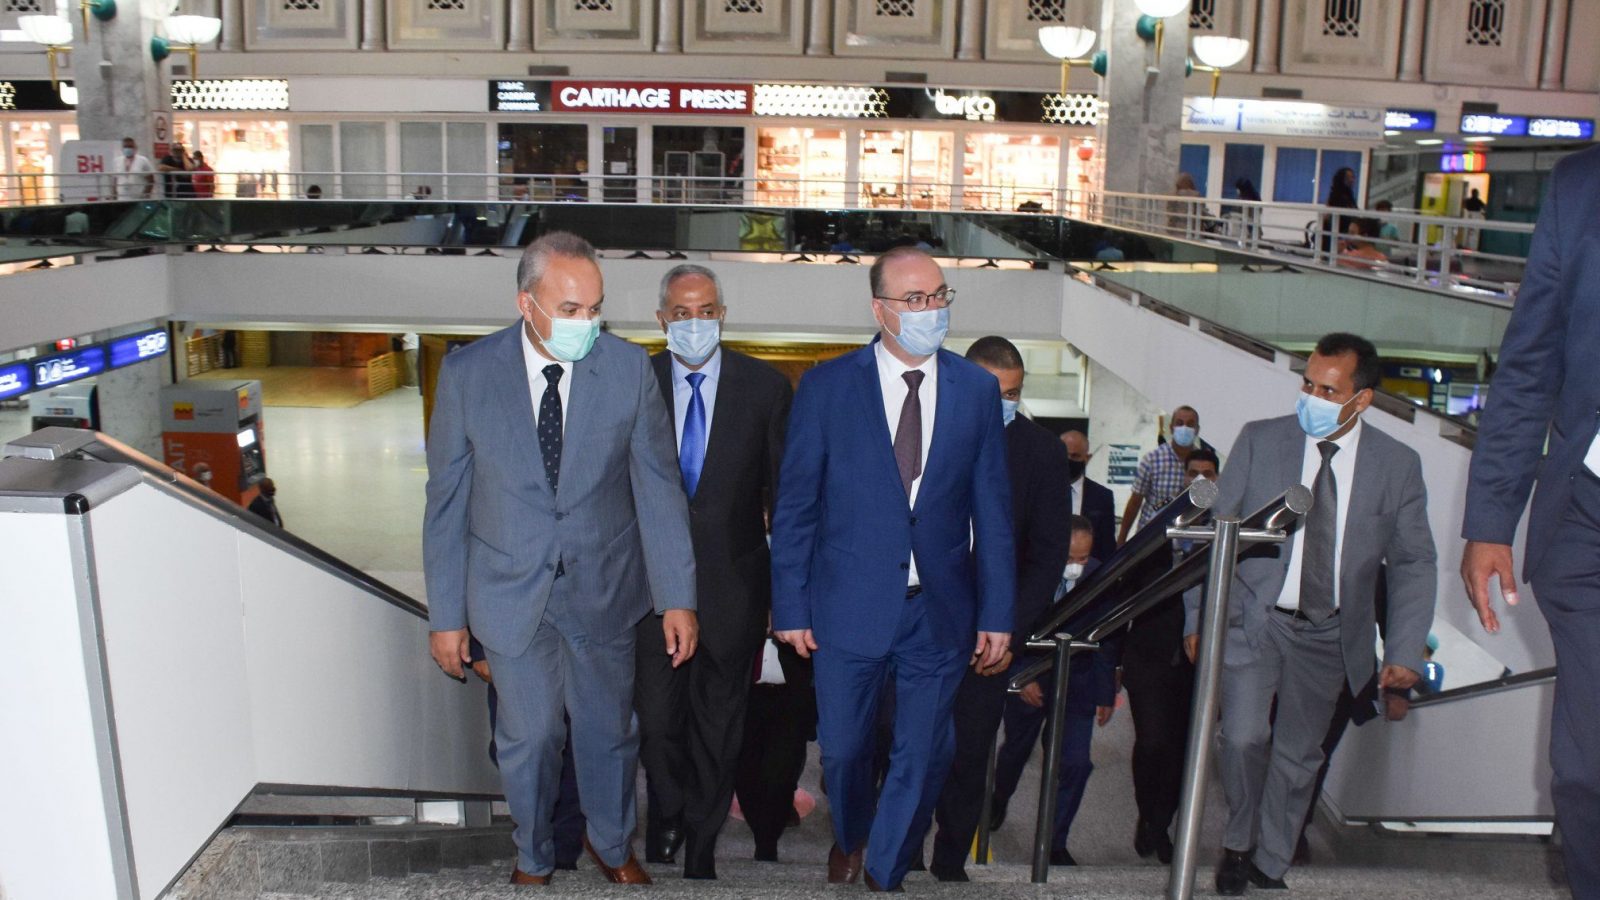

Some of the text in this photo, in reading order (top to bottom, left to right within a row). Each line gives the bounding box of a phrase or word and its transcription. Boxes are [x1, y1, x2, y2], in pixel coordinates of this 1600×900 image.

[560, 87, 747, 110] CARTHAGE PRESSE
[77, 154, 104, 173] BH
